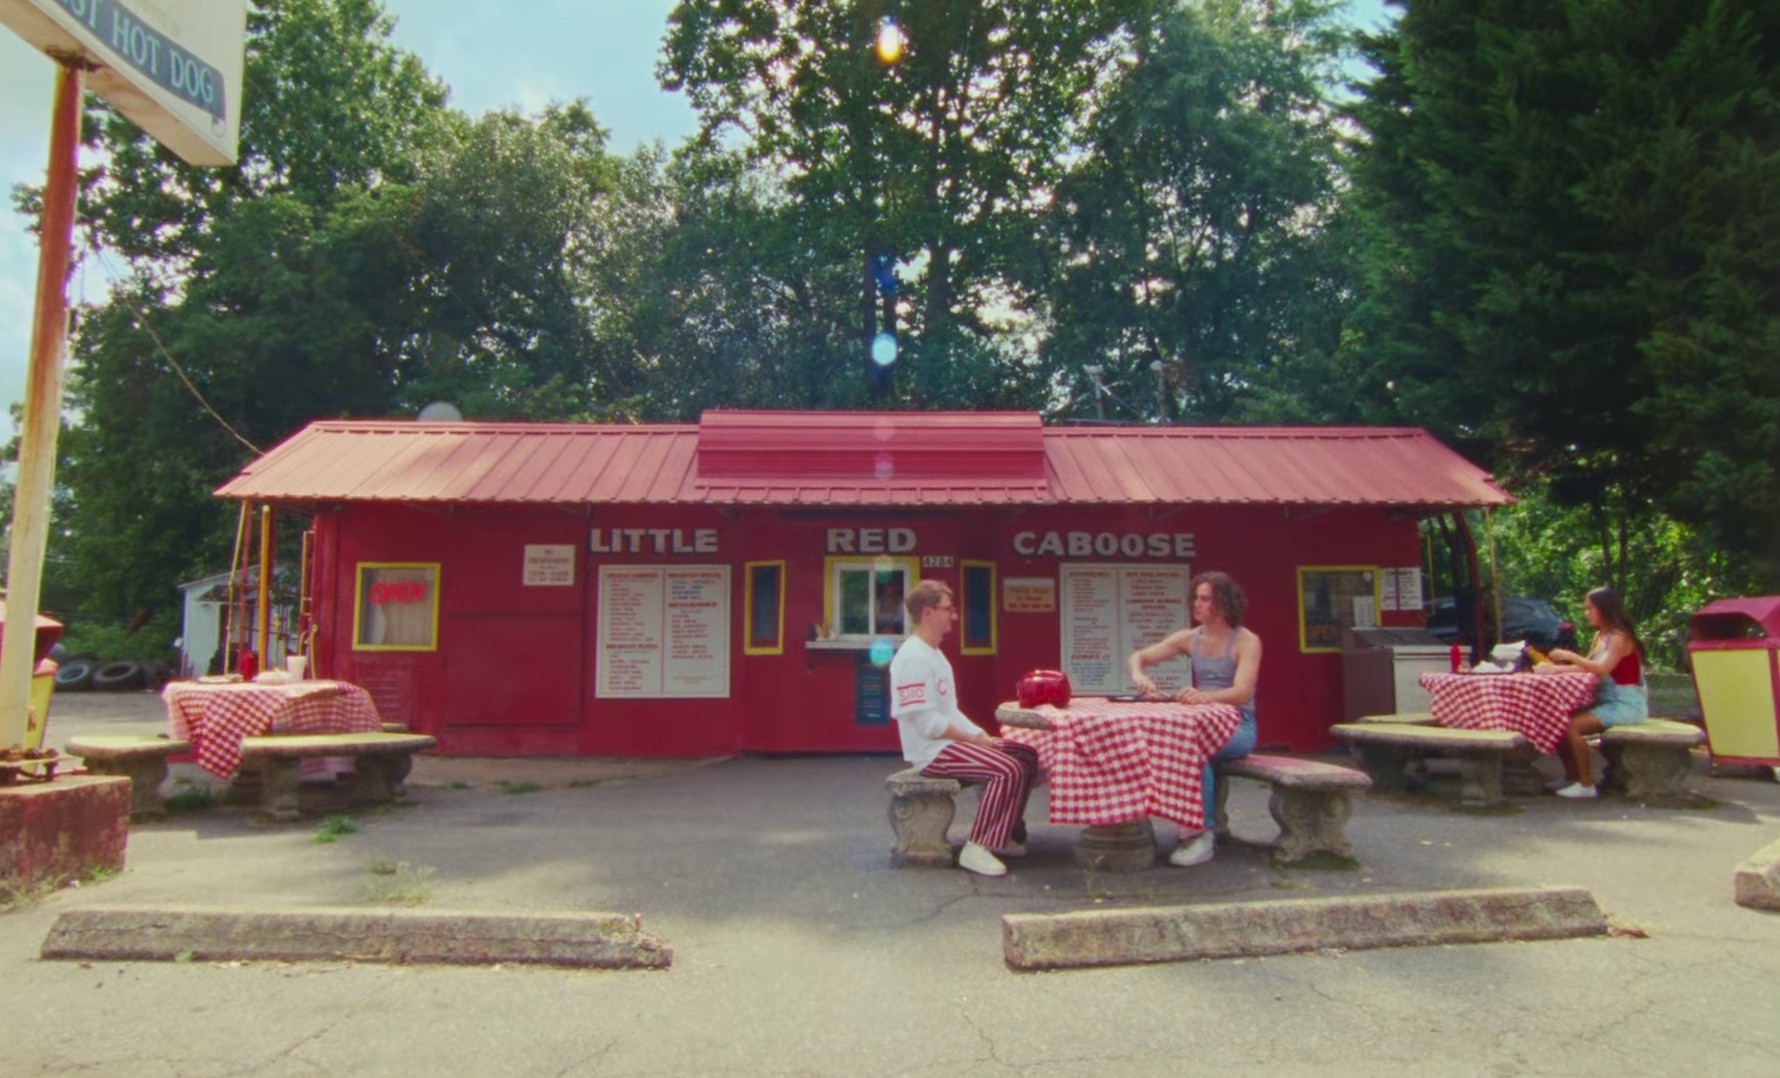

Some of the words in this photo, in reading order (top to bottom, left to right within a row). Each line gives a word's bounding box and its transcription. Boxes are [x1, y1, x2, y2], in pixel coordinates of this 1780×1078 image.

[112, 8, 161, 75] HOT
[169, 50, 214, 104] DOG
[590, 528, 718, 553] LITTLE
[826, 528, 917, 553] RED
[1013, 531, 1196, 557] CABOOSE
[923, 556, 953, 568] 4284
[370, 581, 426, 604] OPEN
